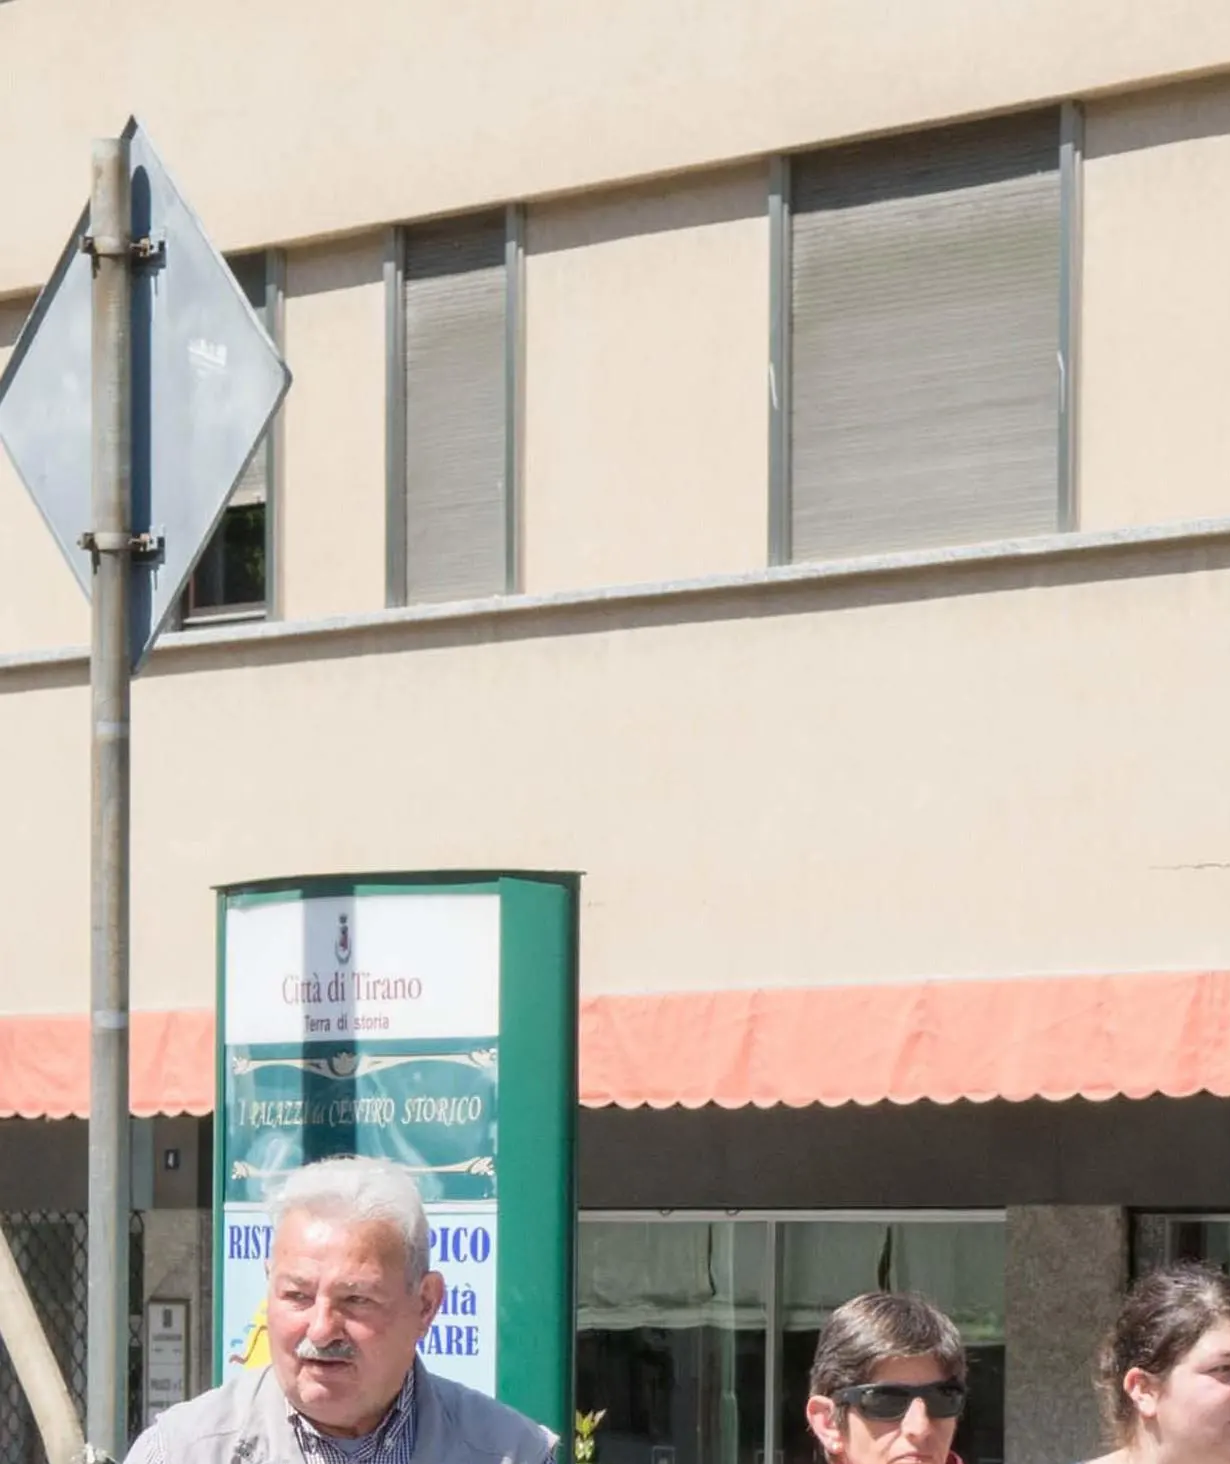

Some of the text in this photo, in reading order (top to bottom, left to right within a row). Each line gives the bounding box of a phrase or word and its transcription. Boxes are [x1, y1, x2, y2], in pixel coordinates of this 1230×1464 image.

[282, 970, 423, 1005] Città di Tirano
[304, 1012, 390, 1032] Terra di storia
[249, 1099, 309, 1128] PALAZZI
[328, 1097, 395, 1129] CENTRO
[401, 1095, 483, 1126] STORICO
